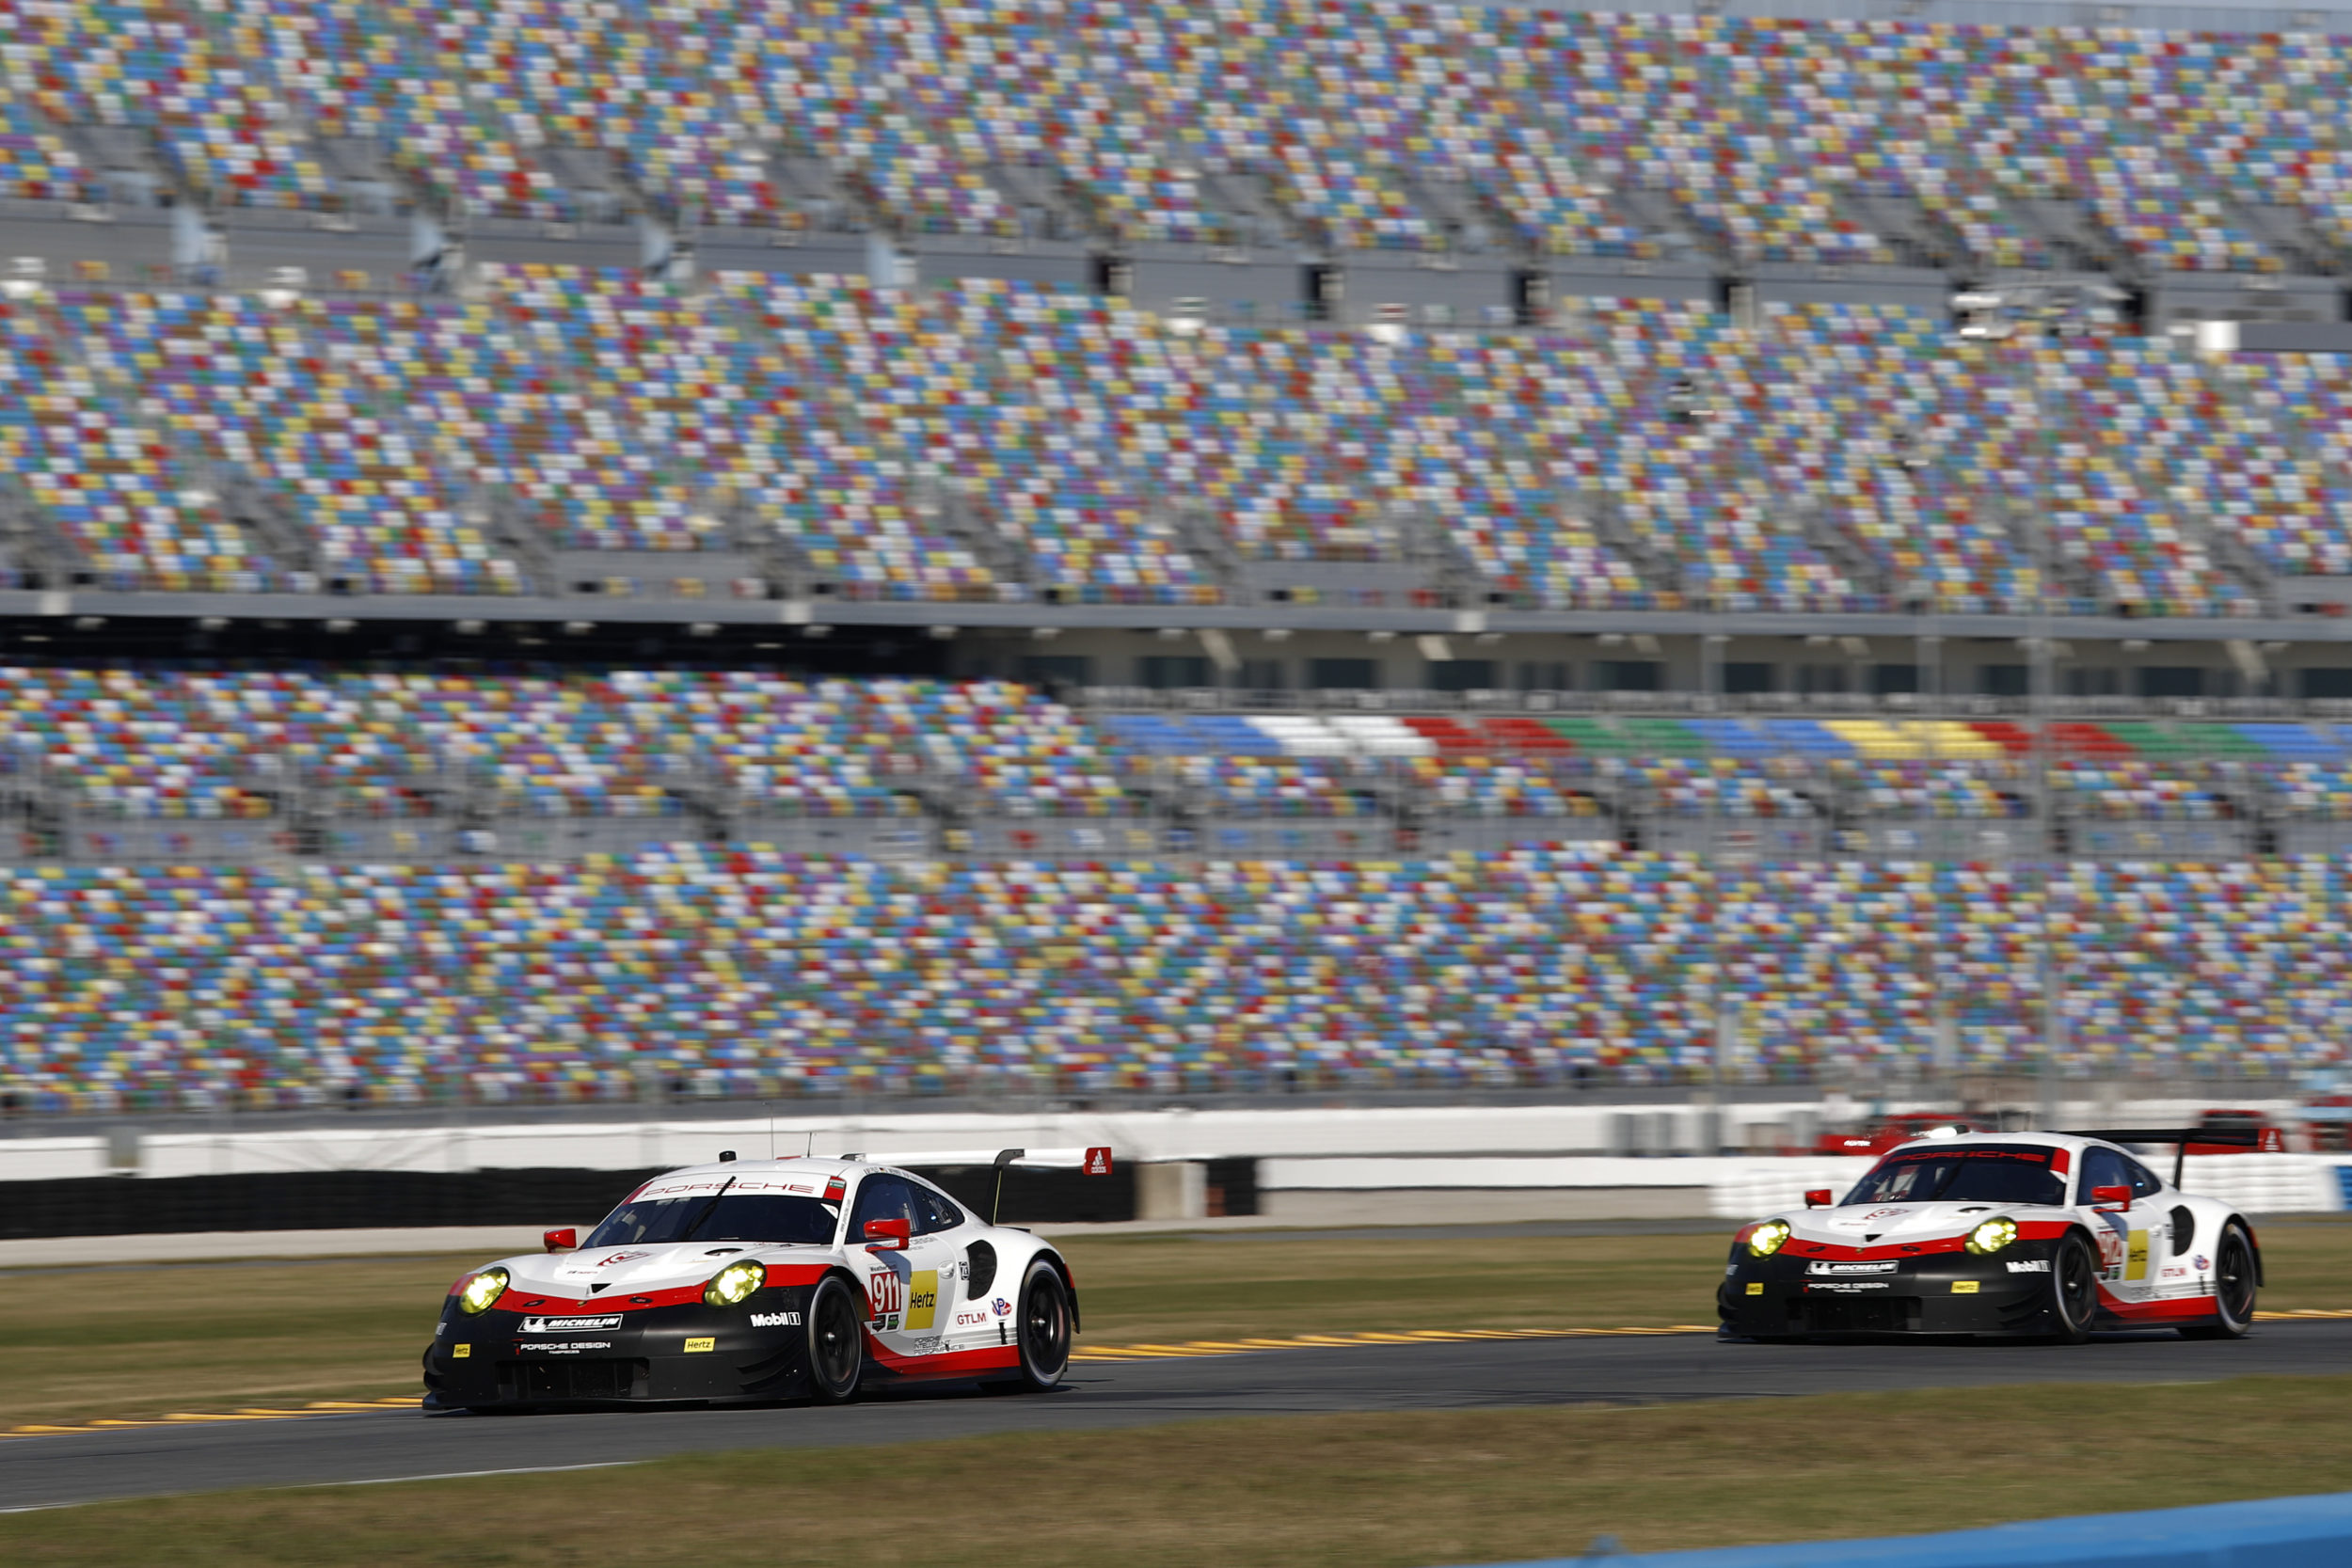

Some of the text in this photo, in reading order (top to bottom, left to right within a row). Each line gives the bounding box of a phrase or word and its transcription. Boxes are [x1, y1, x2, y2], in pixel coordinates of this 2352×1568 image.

[643, 1181, 815, 1198] PORSCHE
[873, 1274, 900, 1312] 911
[910, 1291, 934, 1308] Hertz
[548, 1318, 620, 1327] MICHELIN
[750, 1312, 788, 1327] Mobil
[957, 1312, 987, 1325] GTLM
[687, 1340, 711, 1350] Hertz
